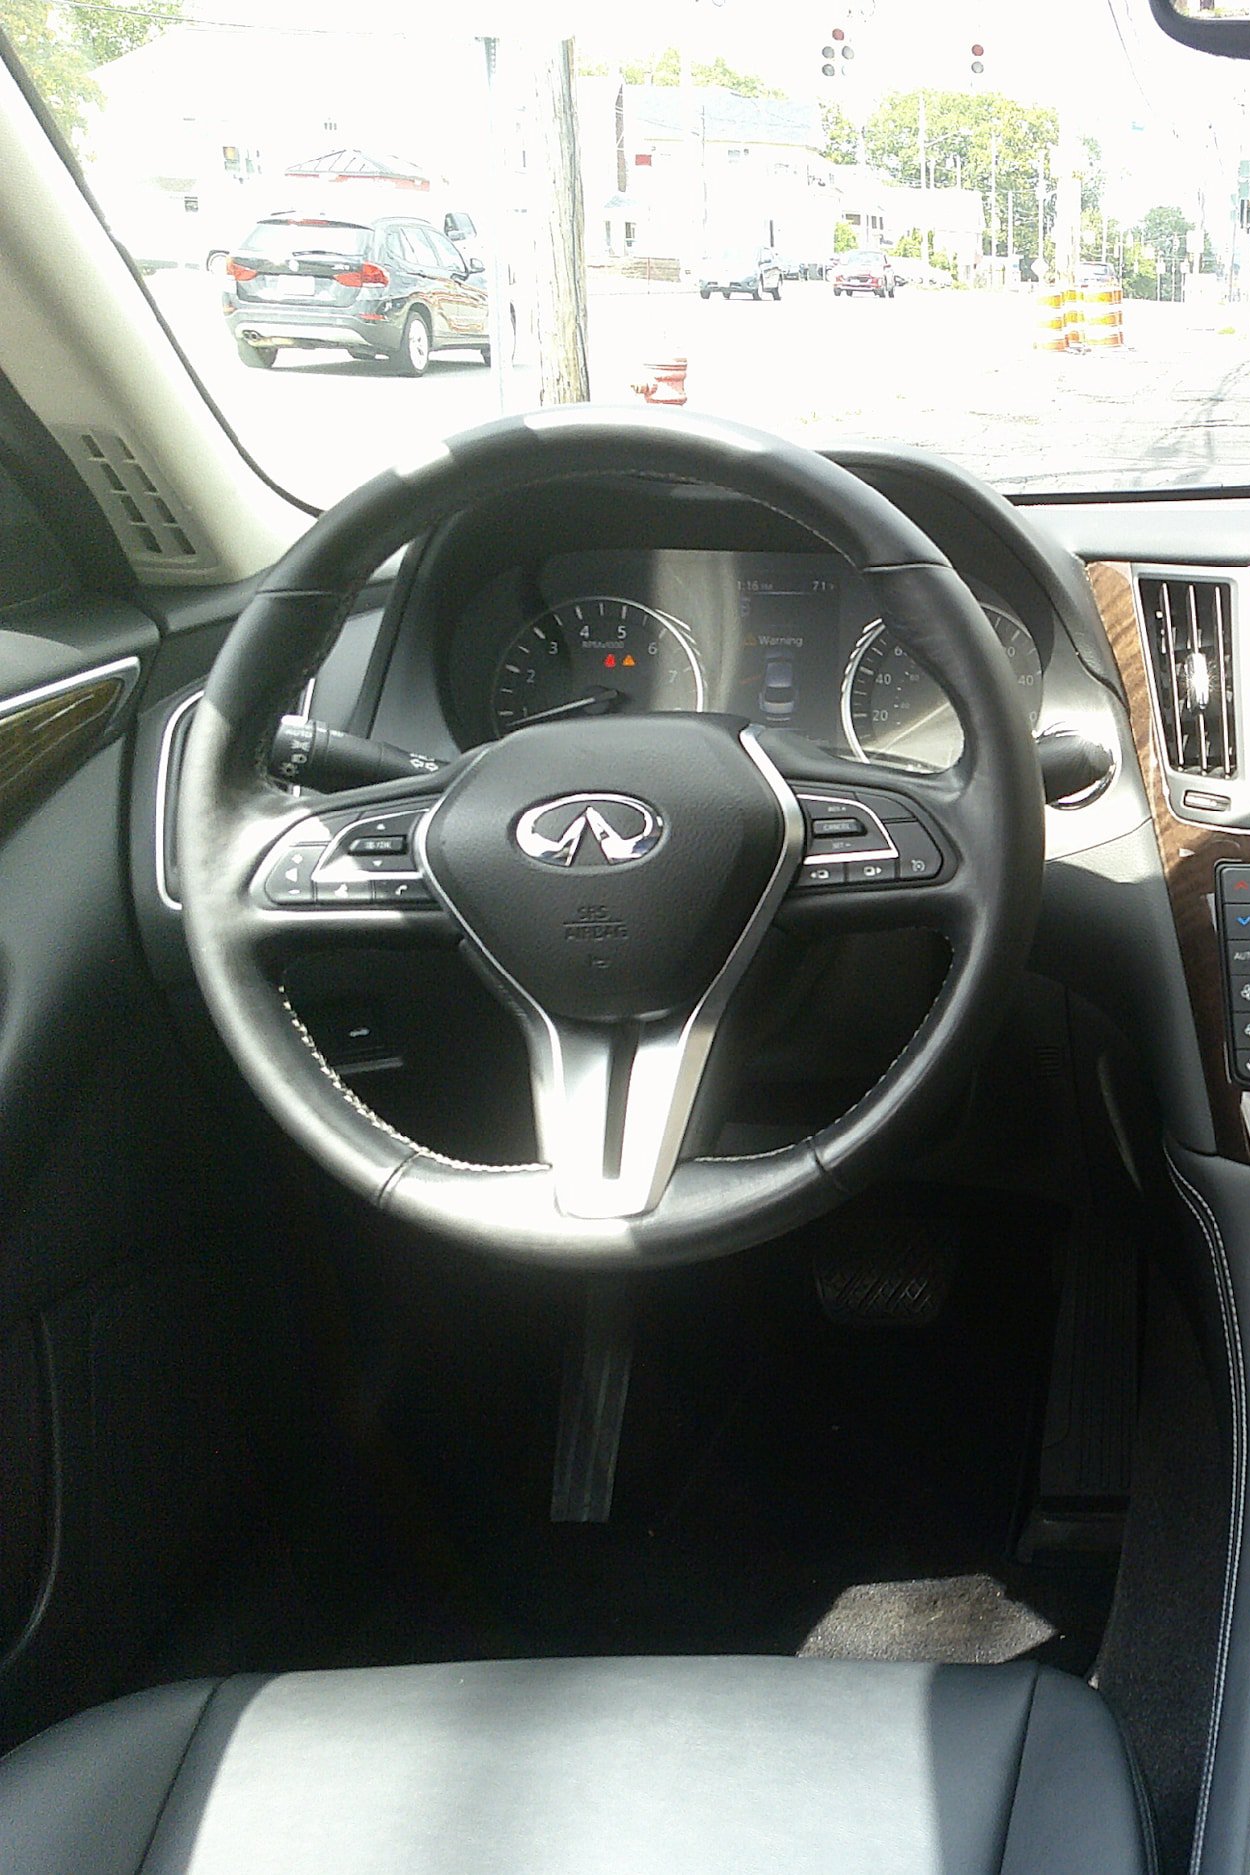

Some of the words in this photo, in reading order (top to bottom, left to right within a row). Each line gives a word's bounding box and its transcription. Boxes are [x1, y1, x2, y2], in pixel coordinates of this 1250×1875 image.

[579, 625, 590, 639] 4
[616, 625, 627, 640] 5
[548, 642, 559, 655] 3
[759, 635, 804, 648] Warning
[647, 642, 658, 656] 6
[526, 668, 536, 684] 2
[668, 669, 678, 683] 7
[875, 673, 892, 685] 40
[872, 710, 889, 722] 20
